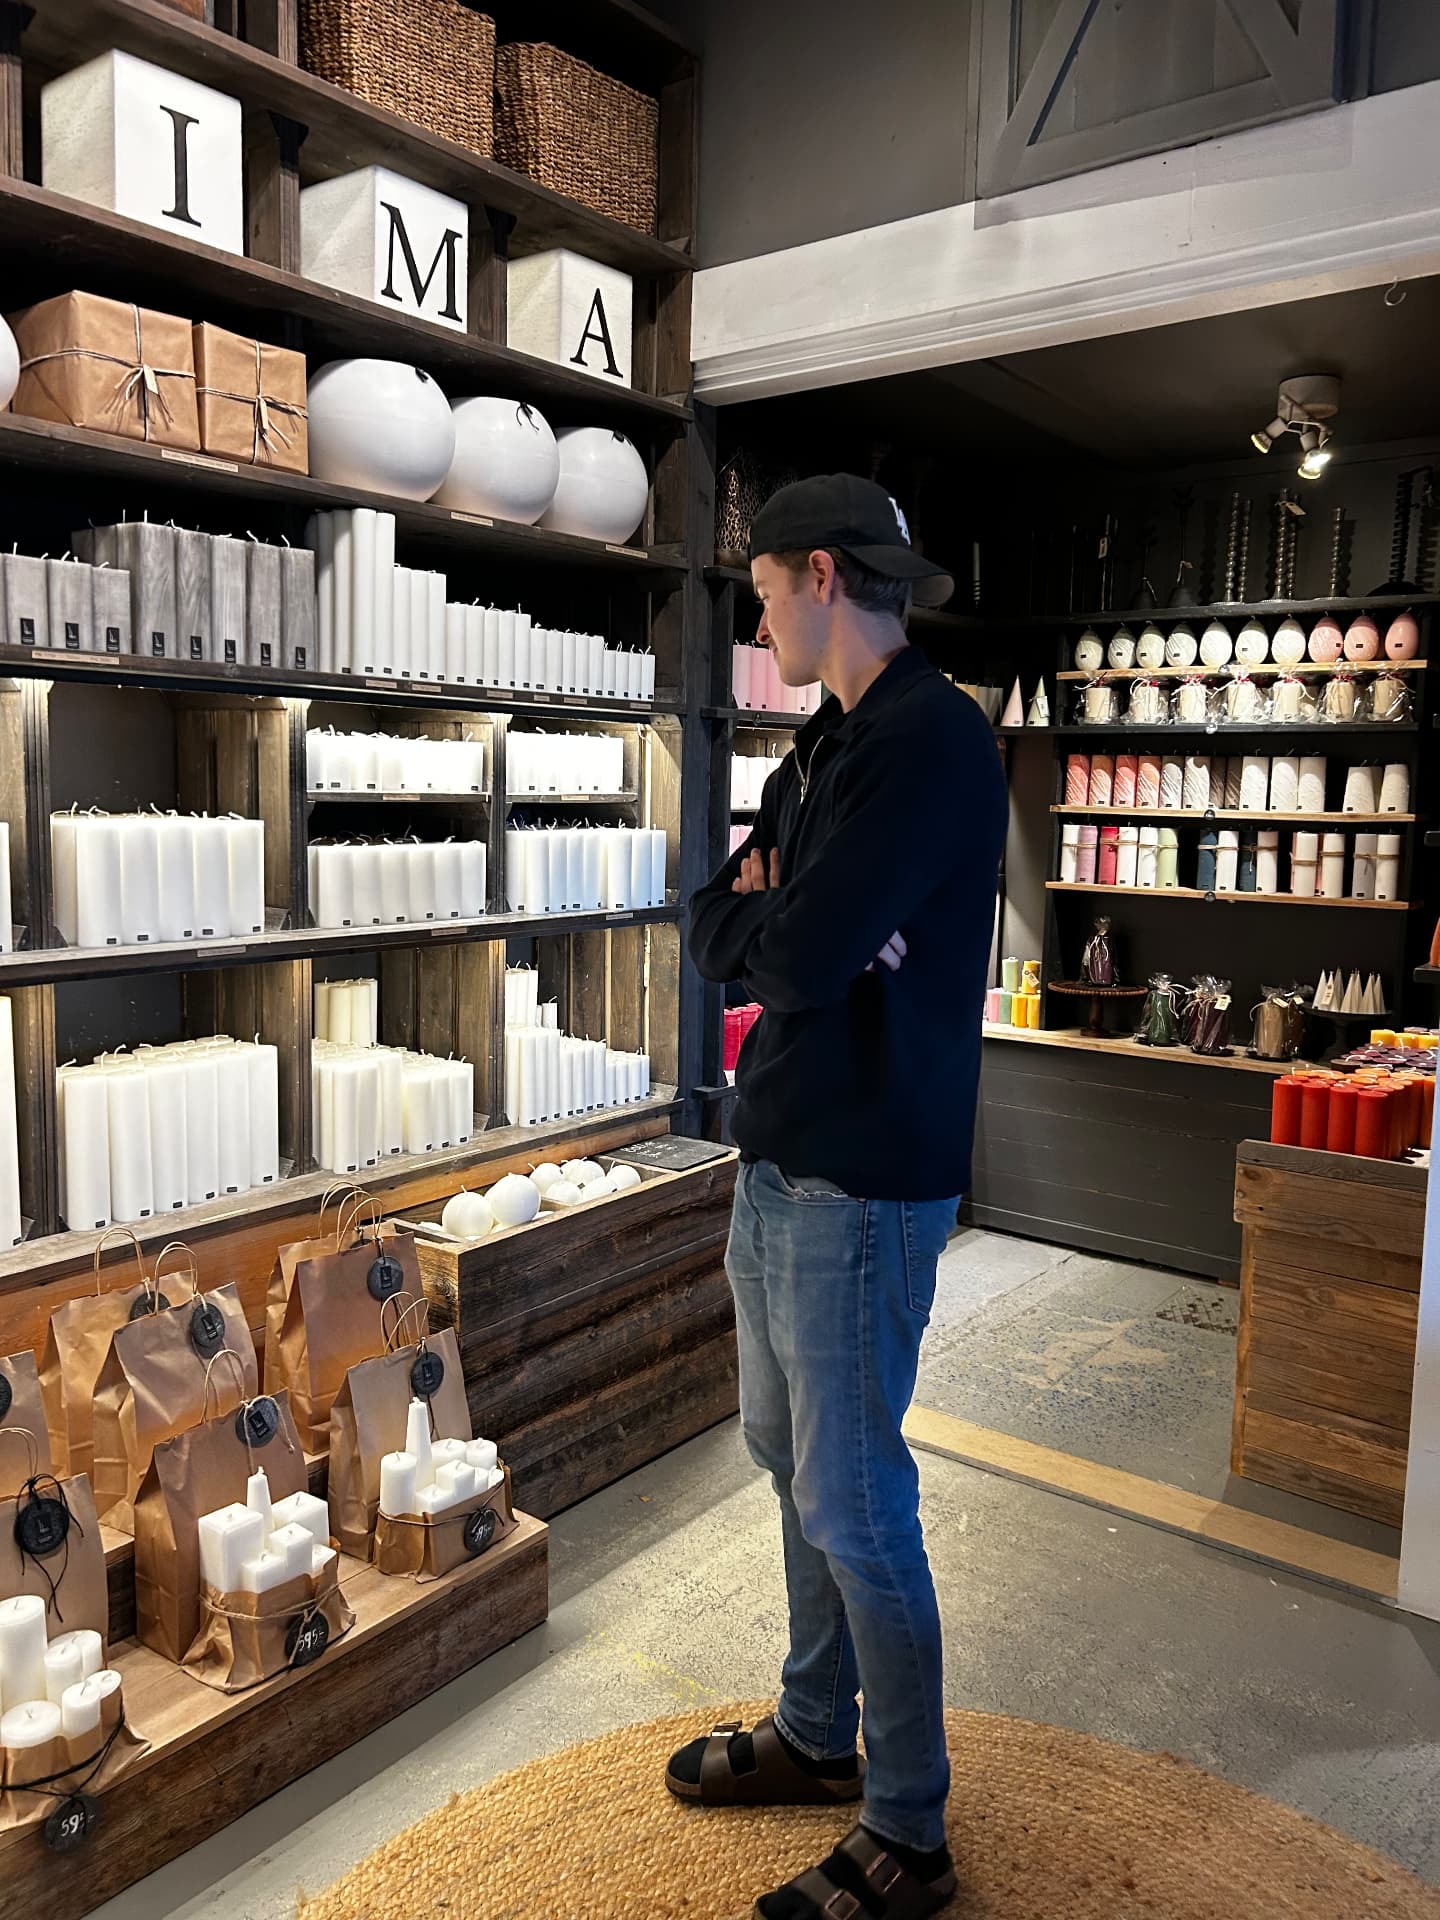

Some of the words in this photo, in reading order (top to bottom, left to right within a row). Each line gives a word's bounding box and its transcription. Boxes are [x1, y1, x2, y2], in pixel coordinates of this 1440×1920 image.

[160, 105, 202, 227] I
[380, 201, 463, 322] M
[569, 287, 624, 378] A
